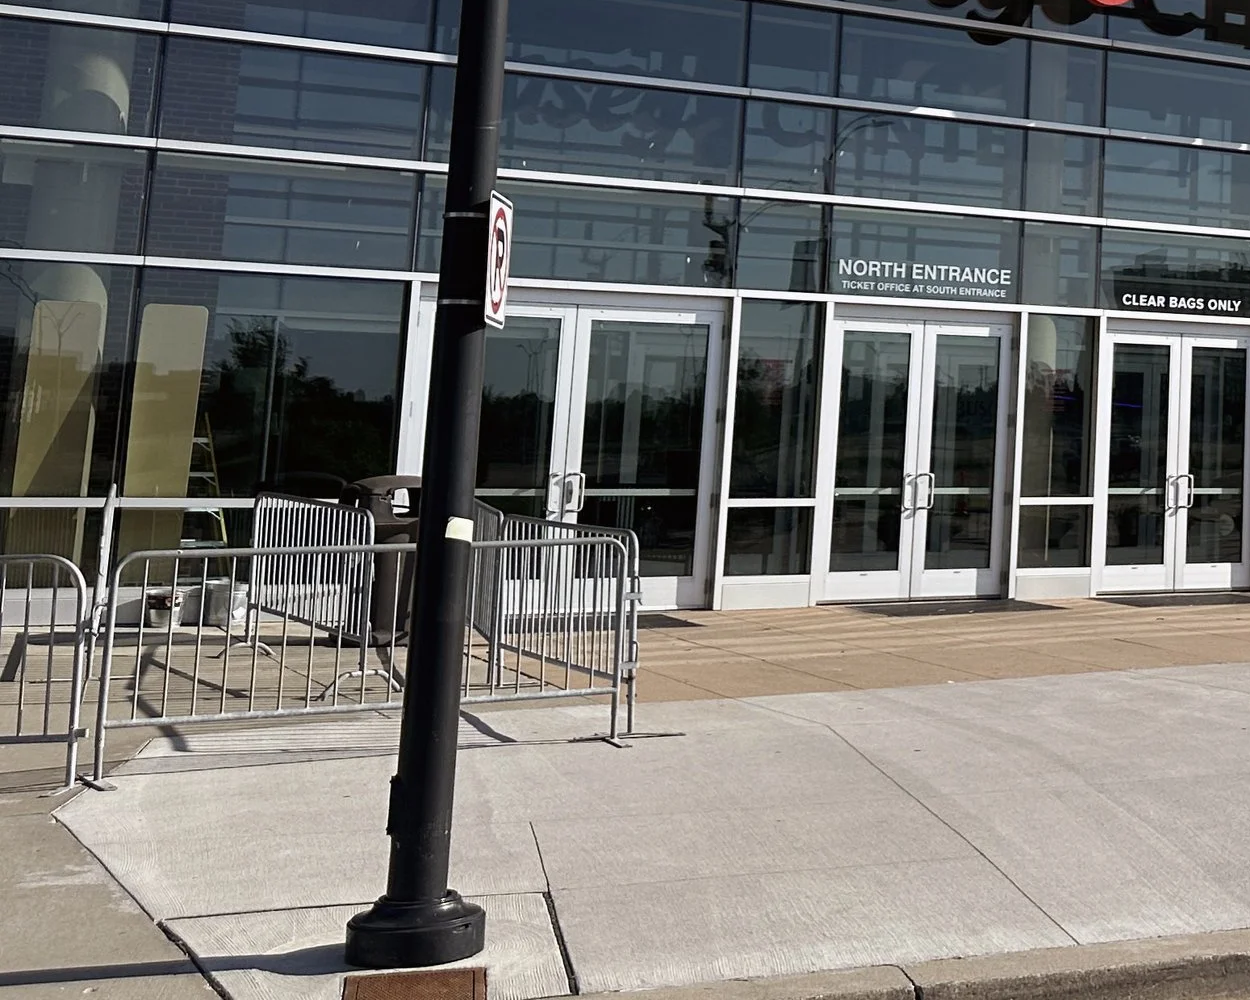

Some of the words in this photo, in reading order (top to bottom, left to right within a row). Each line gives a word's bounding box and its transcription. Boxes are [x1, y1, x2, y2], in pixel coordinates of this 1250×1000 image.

[838, 258, 906, 279] NORTH
[912, 263, 1011, 285] ENTRANCE
[842, 280, 875, 290] TICKET
[877, 282, 911, 292] OFFICE
[912, 284, 925, 293] AT
[926, 285, 957, 295] SOUTH
[959, 287, 1007, 298] ENTRANCE
[1122, 293, 1166, 307] CLEAR
[1169, 296, 1205, 309] BAGS
[1207, 299, 1241, 312] ONLY
